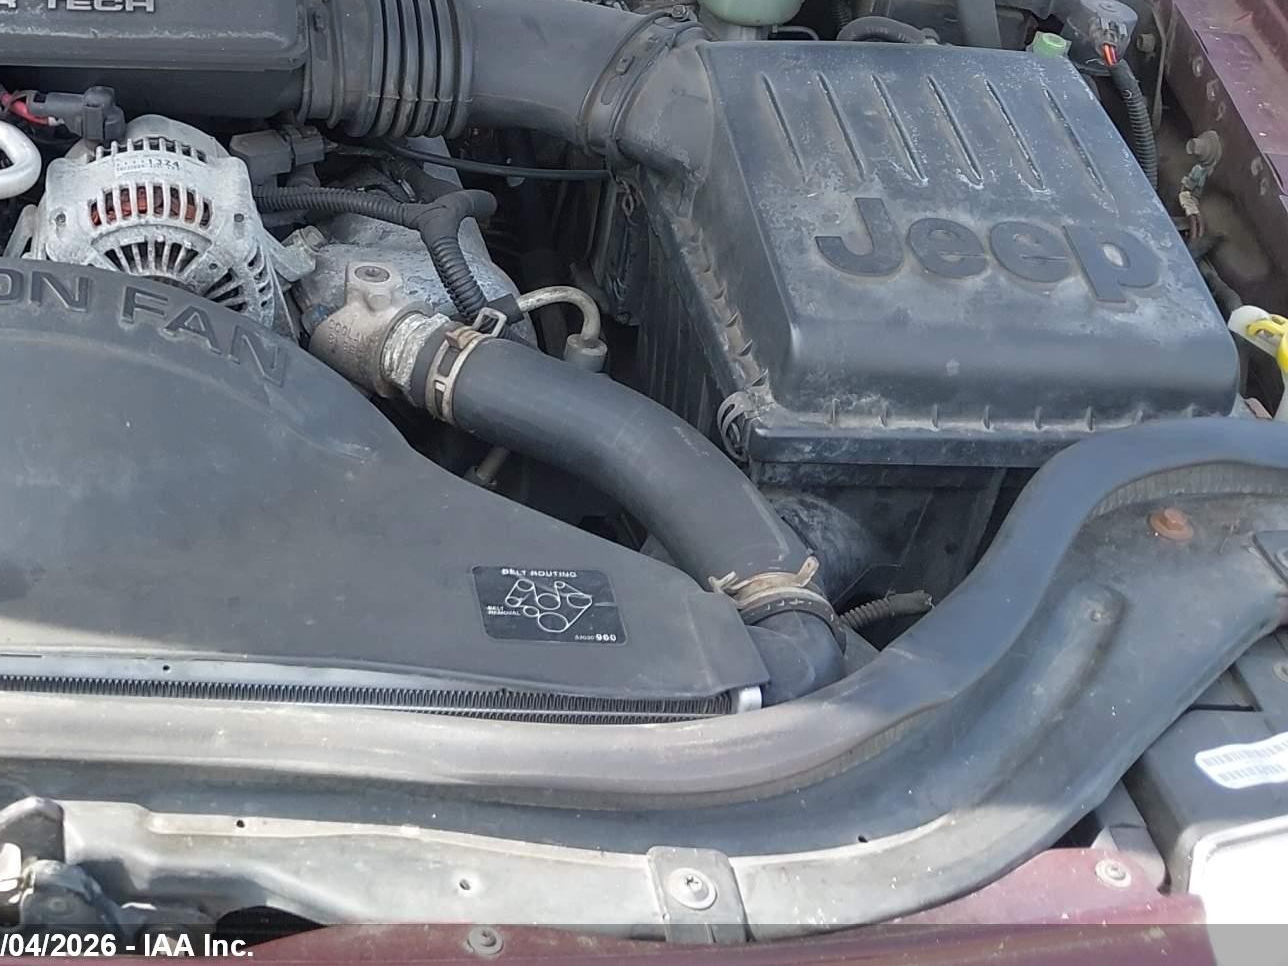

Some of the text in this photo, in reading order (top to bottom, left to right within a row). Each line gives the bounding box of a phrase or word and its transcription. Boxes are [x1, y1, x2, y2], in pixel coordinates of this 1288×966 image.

[814, 196, 1162, 303] Jeep
[119, 285, 289, 387] FAN
[501, 568, 577, 578] BELT ROUTING
